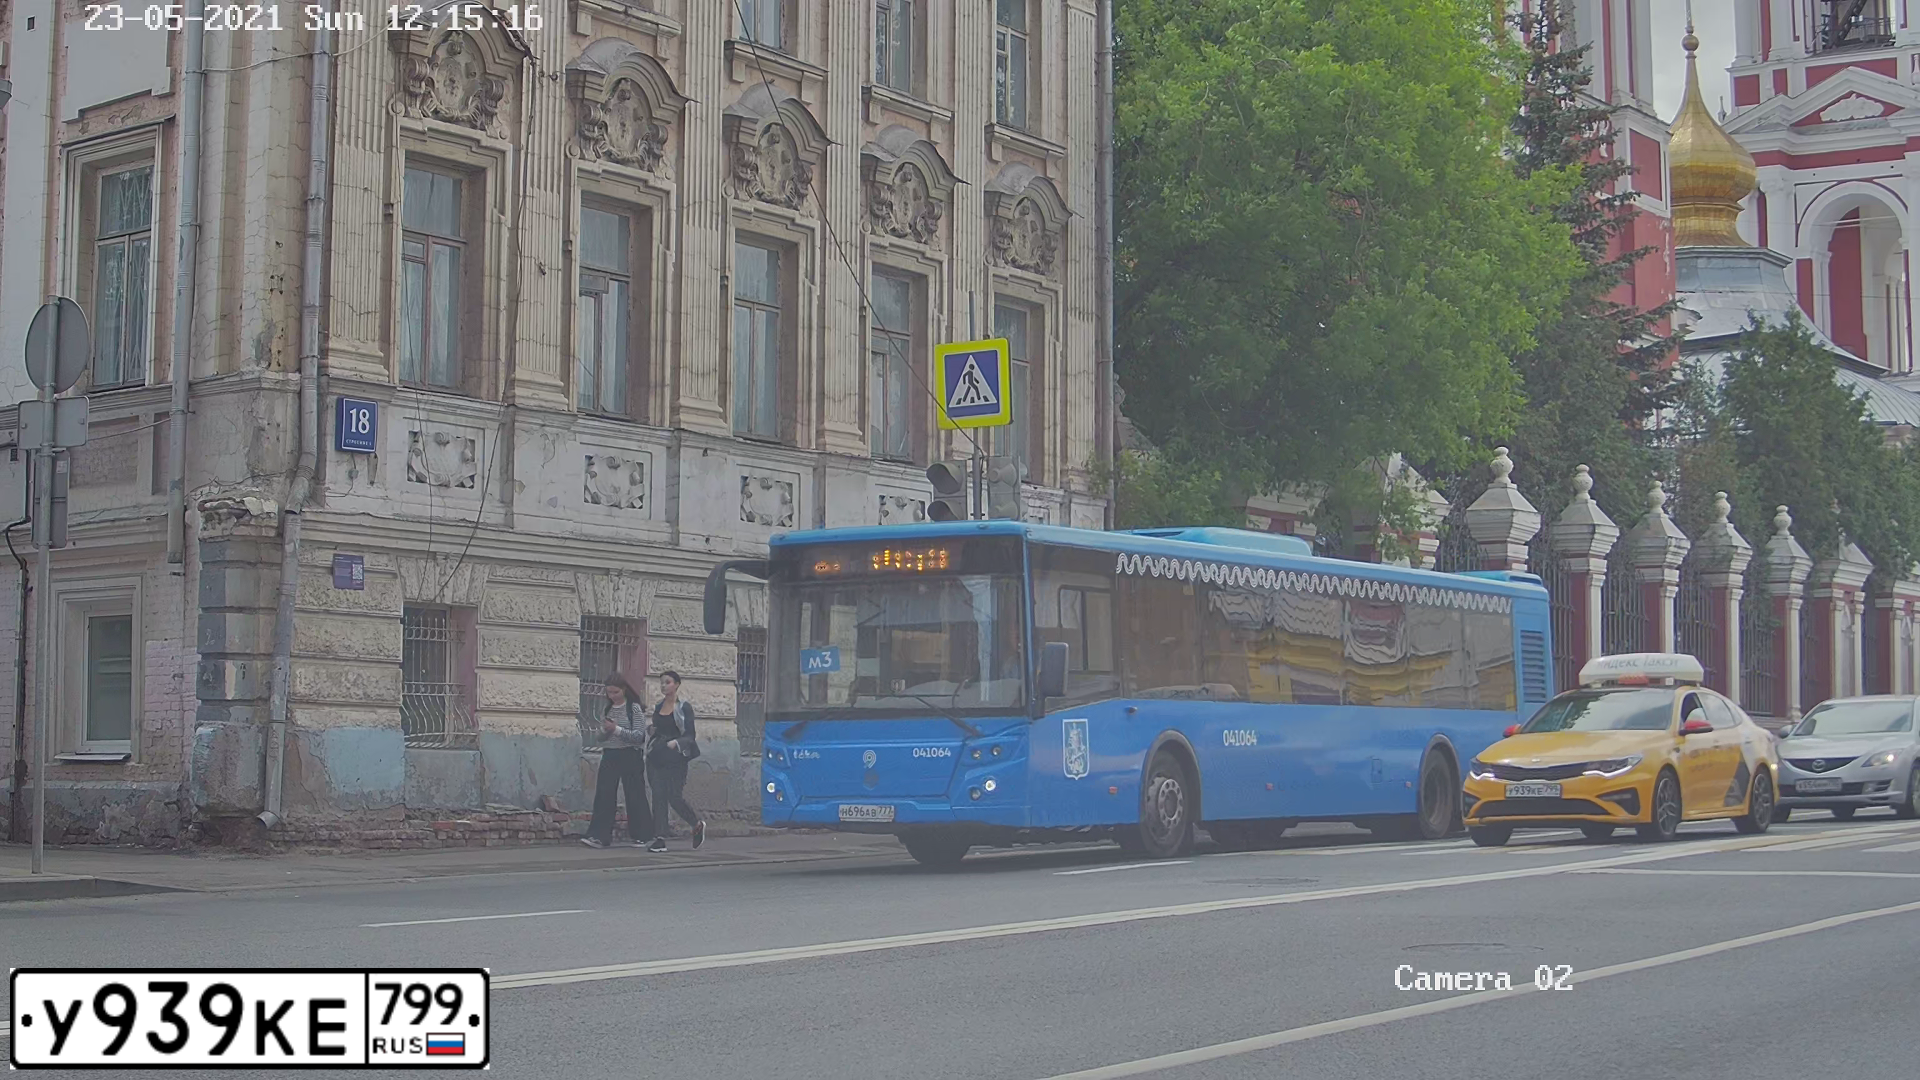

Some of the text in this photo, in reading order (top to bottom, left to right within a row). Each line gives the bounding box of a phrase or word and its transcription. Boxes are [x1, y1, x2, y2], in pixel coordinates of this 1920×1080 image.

[349, 407, 370, 434] 18
[1223, 729, 1258, 747] 041064
[912, 747, 952, 758] 041064
